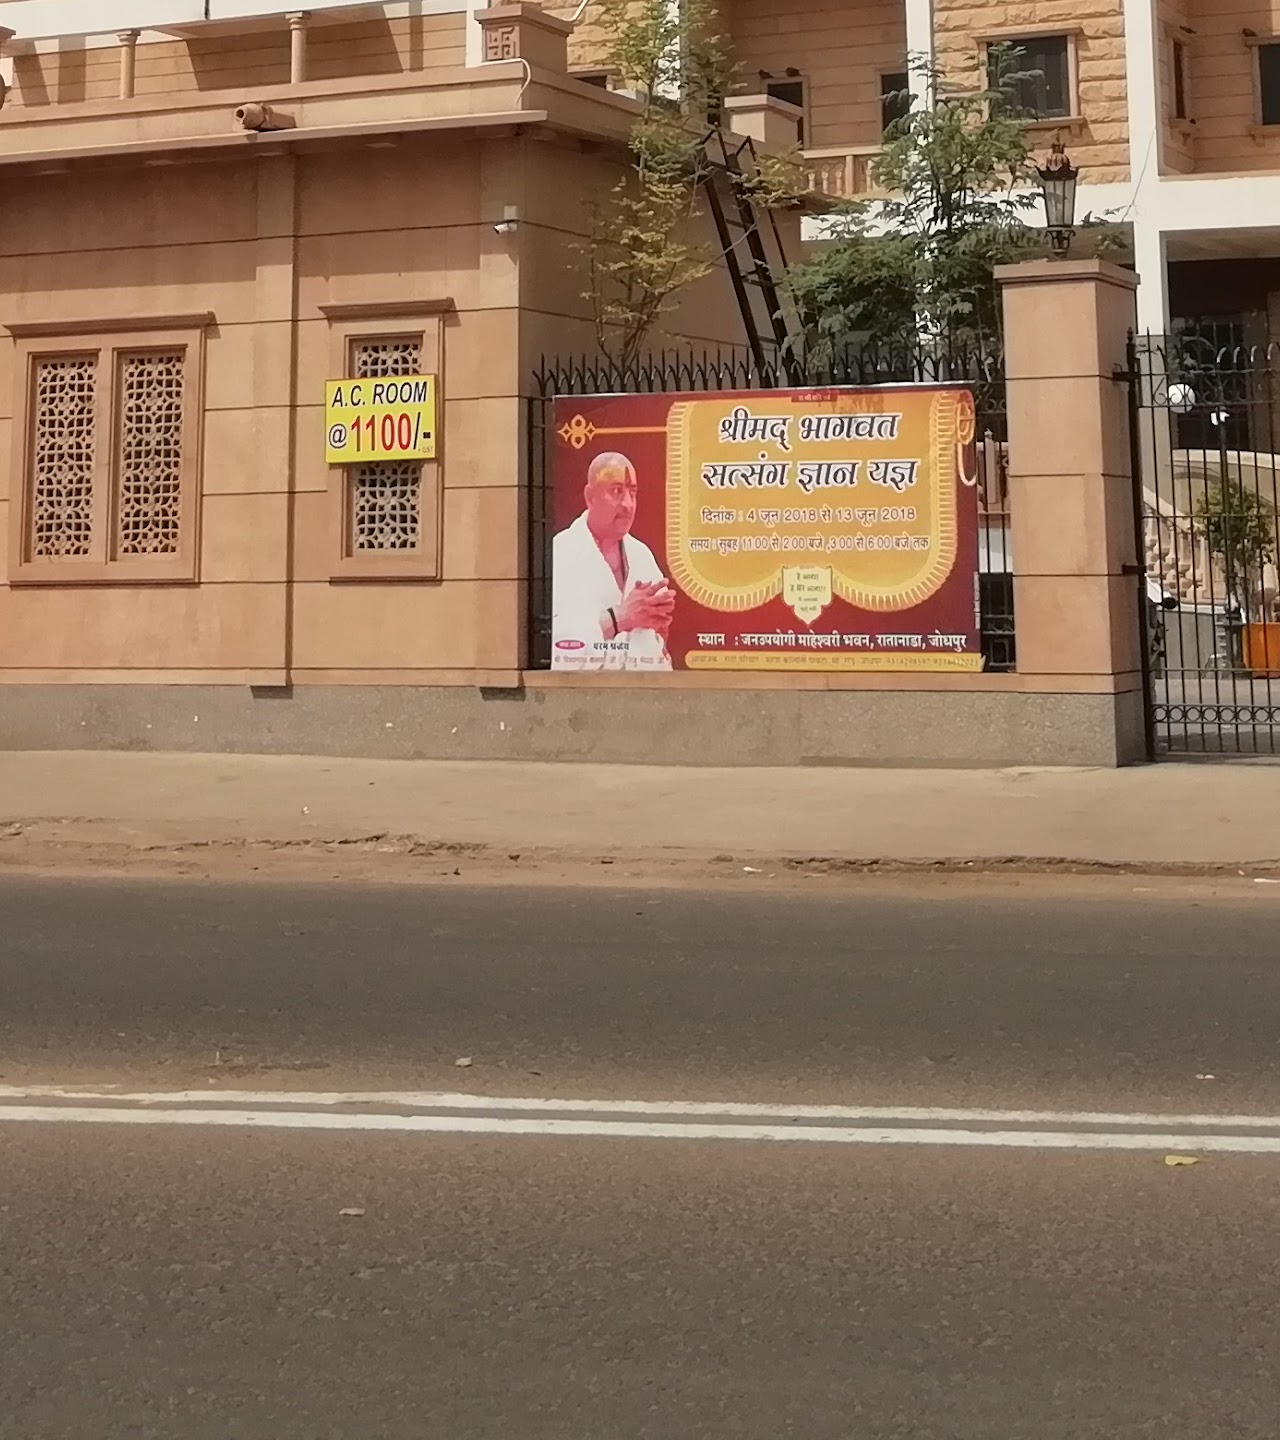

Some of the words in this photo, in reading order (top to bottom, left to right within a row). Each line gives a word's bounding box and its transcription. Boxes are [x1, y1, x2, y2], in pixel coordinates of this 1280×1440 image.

[331, 384, 366, 408] A.C.
[372, 381, 428, 405] ROOM
[719, 407, 792, 450] श्रीमद्
[800, 414, 900, 440] भागवत
[702, 452, 790, 487] सत्संग
[798, 462, 859, 492] ज्ञान
[868, 460, 918, 491] यज्ञ
[702, 506, 735, 522] दिनांक
[747, 510, 755, 521] 4
[760, 510, 779, 526] जून
[785, 509, 816, 521] 2018
[821, 505, 831, 521] से
[837, 509, 852, 521] 13
[856, 509, 876, 525] जून
[882, 507, 915, 520] 2018
[772, 533, 779, 549] से
[809, 533, 823, 549] बजे
[856, 532, 864, 548] से
[894, 532, 909, 548] बजे
[913, 537, 929, 548] तक
[697, 633, 726, 646] स्थान
[797, 628, 840, 649] माहेश्वरी
[927, 628, 967, 652] जोधपुर
